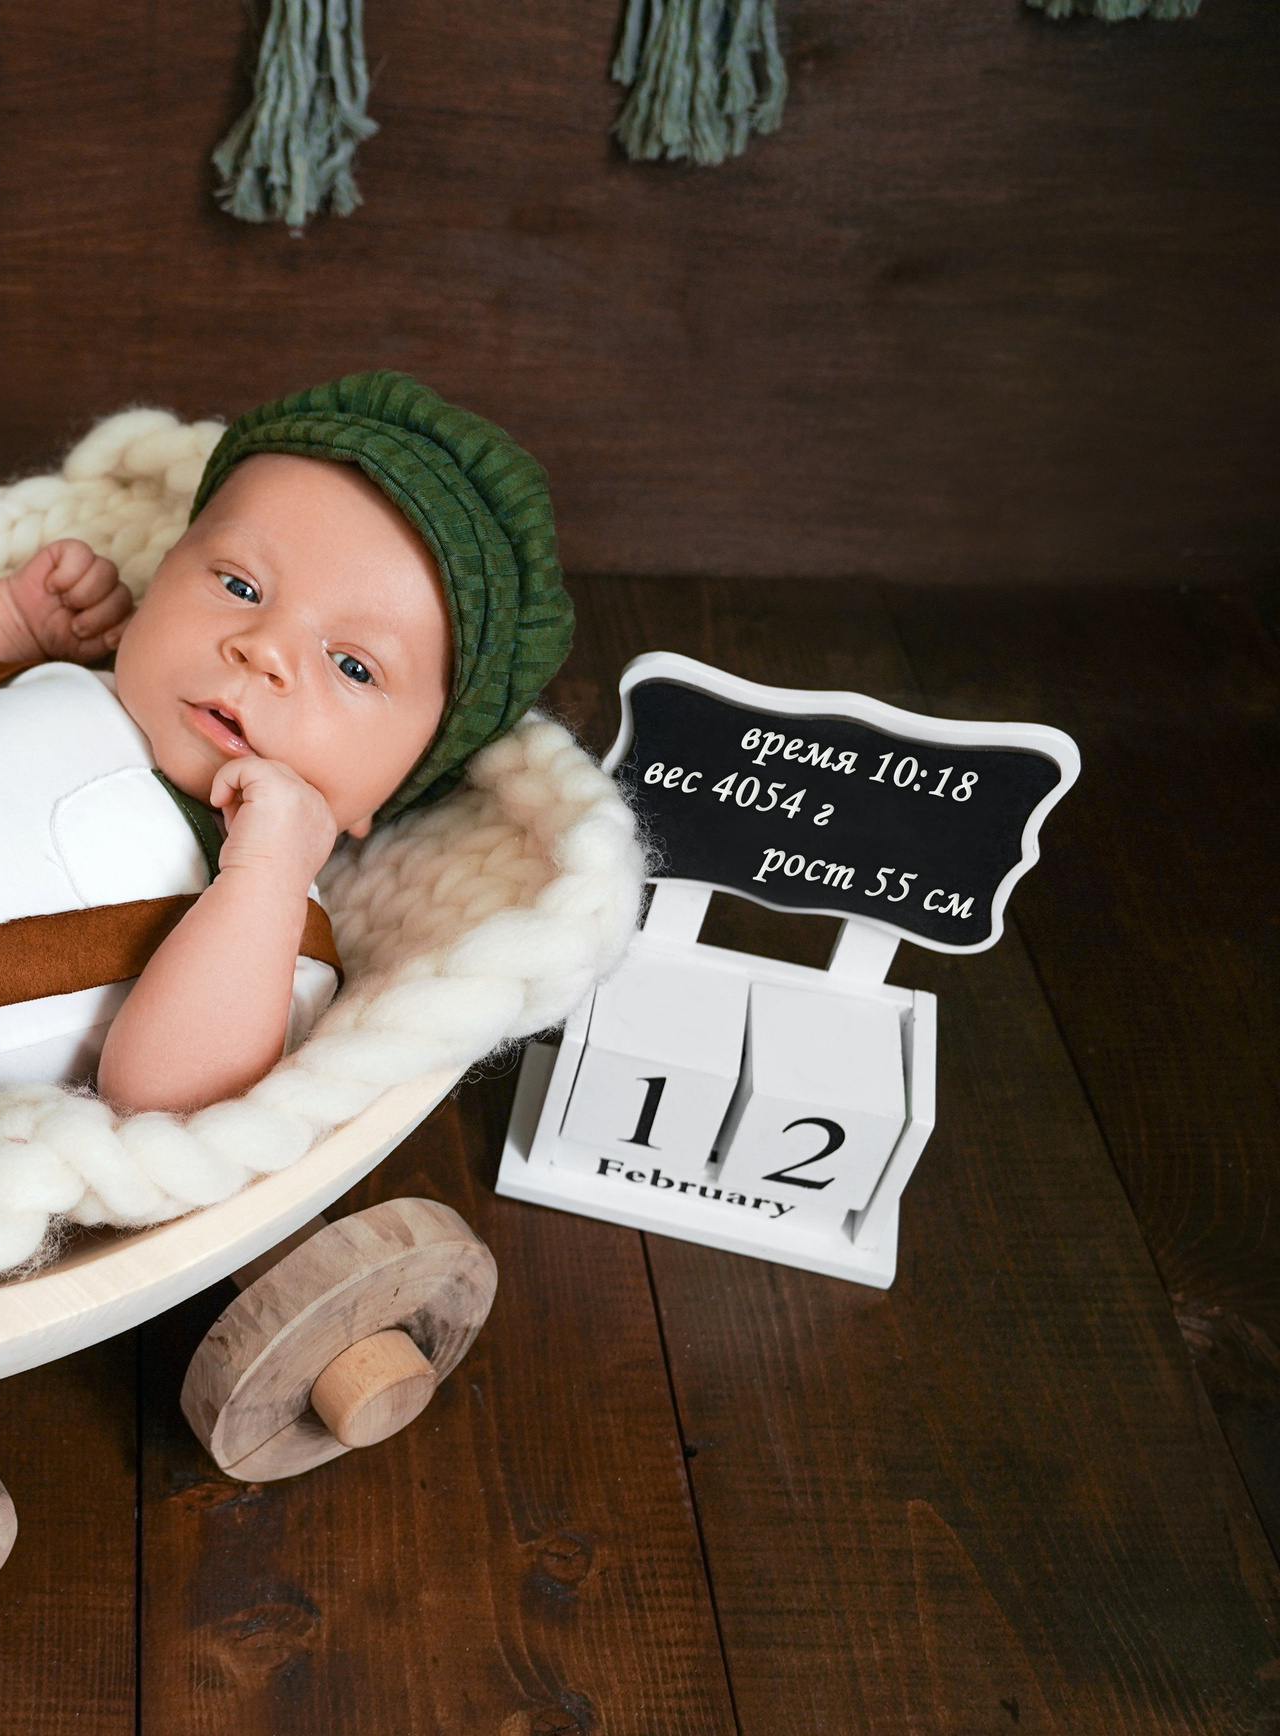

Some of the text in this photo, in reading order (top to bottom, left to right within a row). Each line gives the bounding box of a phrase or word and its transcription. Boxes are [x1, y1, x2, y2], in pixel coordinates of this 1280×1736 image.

[643, 762, 835, 826] вес 4054 г
[740, 727, 979, 802] время 10:18
[752, 847, 975, 919] рост 55 см
[595, 1157, 797, 1219] February
